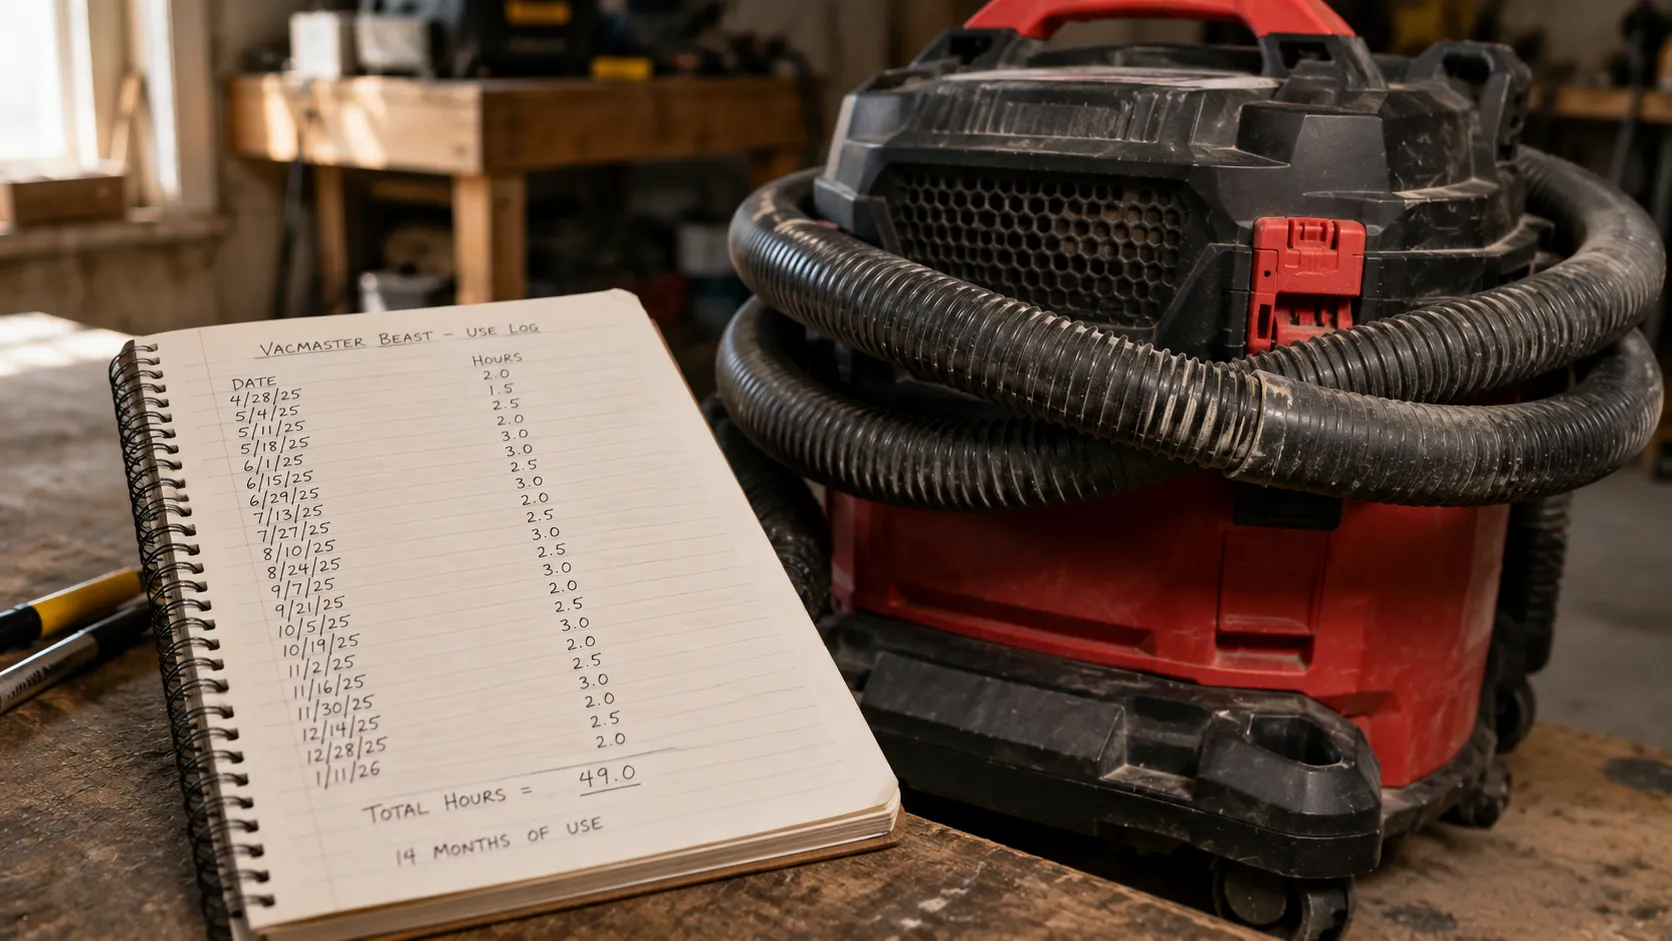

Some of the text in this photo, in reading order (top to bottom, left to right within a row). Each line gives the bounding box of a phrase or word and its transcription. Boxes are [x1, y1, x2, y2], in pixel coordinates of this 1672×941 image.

[259, 338, 366, 356] VACMASTER
[378, 332, 433, 346] BEAST
[466, 326, 496, 338] USE
[508, 323, 539, 335] LOG
[472, 352, 523, 367] HOURS
[231, 375, 277, 391] DATE
[483, 368, 510, 380] 2.0
[229, 388, 302, 408] 4/28/25
[489, 382, 514, 396] 1.5
[492, 397, 519, 411] 2.5
[235, 404, 300, 424] 5/4/25
[496, 414, 524, 426] 2.0
[238, 420, 306, 440] 5/11/25
[501, 428, 529, 442] 3.0
[240, 435, 311, 458] 5/18/25
[504, 443, 533, 457] 3.0
[243, 454, 304, 475] 6/1/25
[510, 458, 538, 473] 2.5
[246, 470, 314, 492] 6/15/25
[515, 475, 544, 489] 3.0
[249, 487, 320, 510] 6/29/25
[520, 492, 549, 506] 2.0
[252, 504, 324, 527] 7/13/25
[526, 508, 554, 523] 2.5
[256, 521, 331, 546] 7/27/25
[531, 526, 560, 541] 3.0
[262, 539, 336, 563] 8/10/25
[536, 542, 566, 558] 2.5
[267, 557, 341, 582] 8/24/25
[542, 561, 572, 577] 3.0
[270, 577, 336, 601] 9/7/25
[548, 579, 578, 594] 2.0
[274, 595, 346, 622] 9/21/25
[554, 596, 583, 613] 2.5
[278, 614, 351, 641] 10/5/25
[559, 616, 590, 632] 3.0
[283, 633, 361, 660] 10/19/25
[566, 635, 596, 651] 2.0
[289, 654, 356, 680] 11/2/25
[572, 652, 602, 670] 2.5
[294, 674, 366, 701] 11/16/25
[578, 673, 609, 690] 3.0
[298, 694, 375, 723] 11/30/25
[584, 691, 615, 709] 2.0
[589, 710, 620, 729] 2.5
[303, 715, 381, 744] 12/14/25
[595, 732, 626, 749] 2.0
[307, 736, 388, 765] 12/28/25
[316, 761, 381, 789] 1/11/26
[362, 802, 429, 823] TOTAL
[443, 788, 507, 811] HOURS
[579, 764, 636, 787] 49.0
[396, 816, 603, 865] 14 MONTHS OF USE
